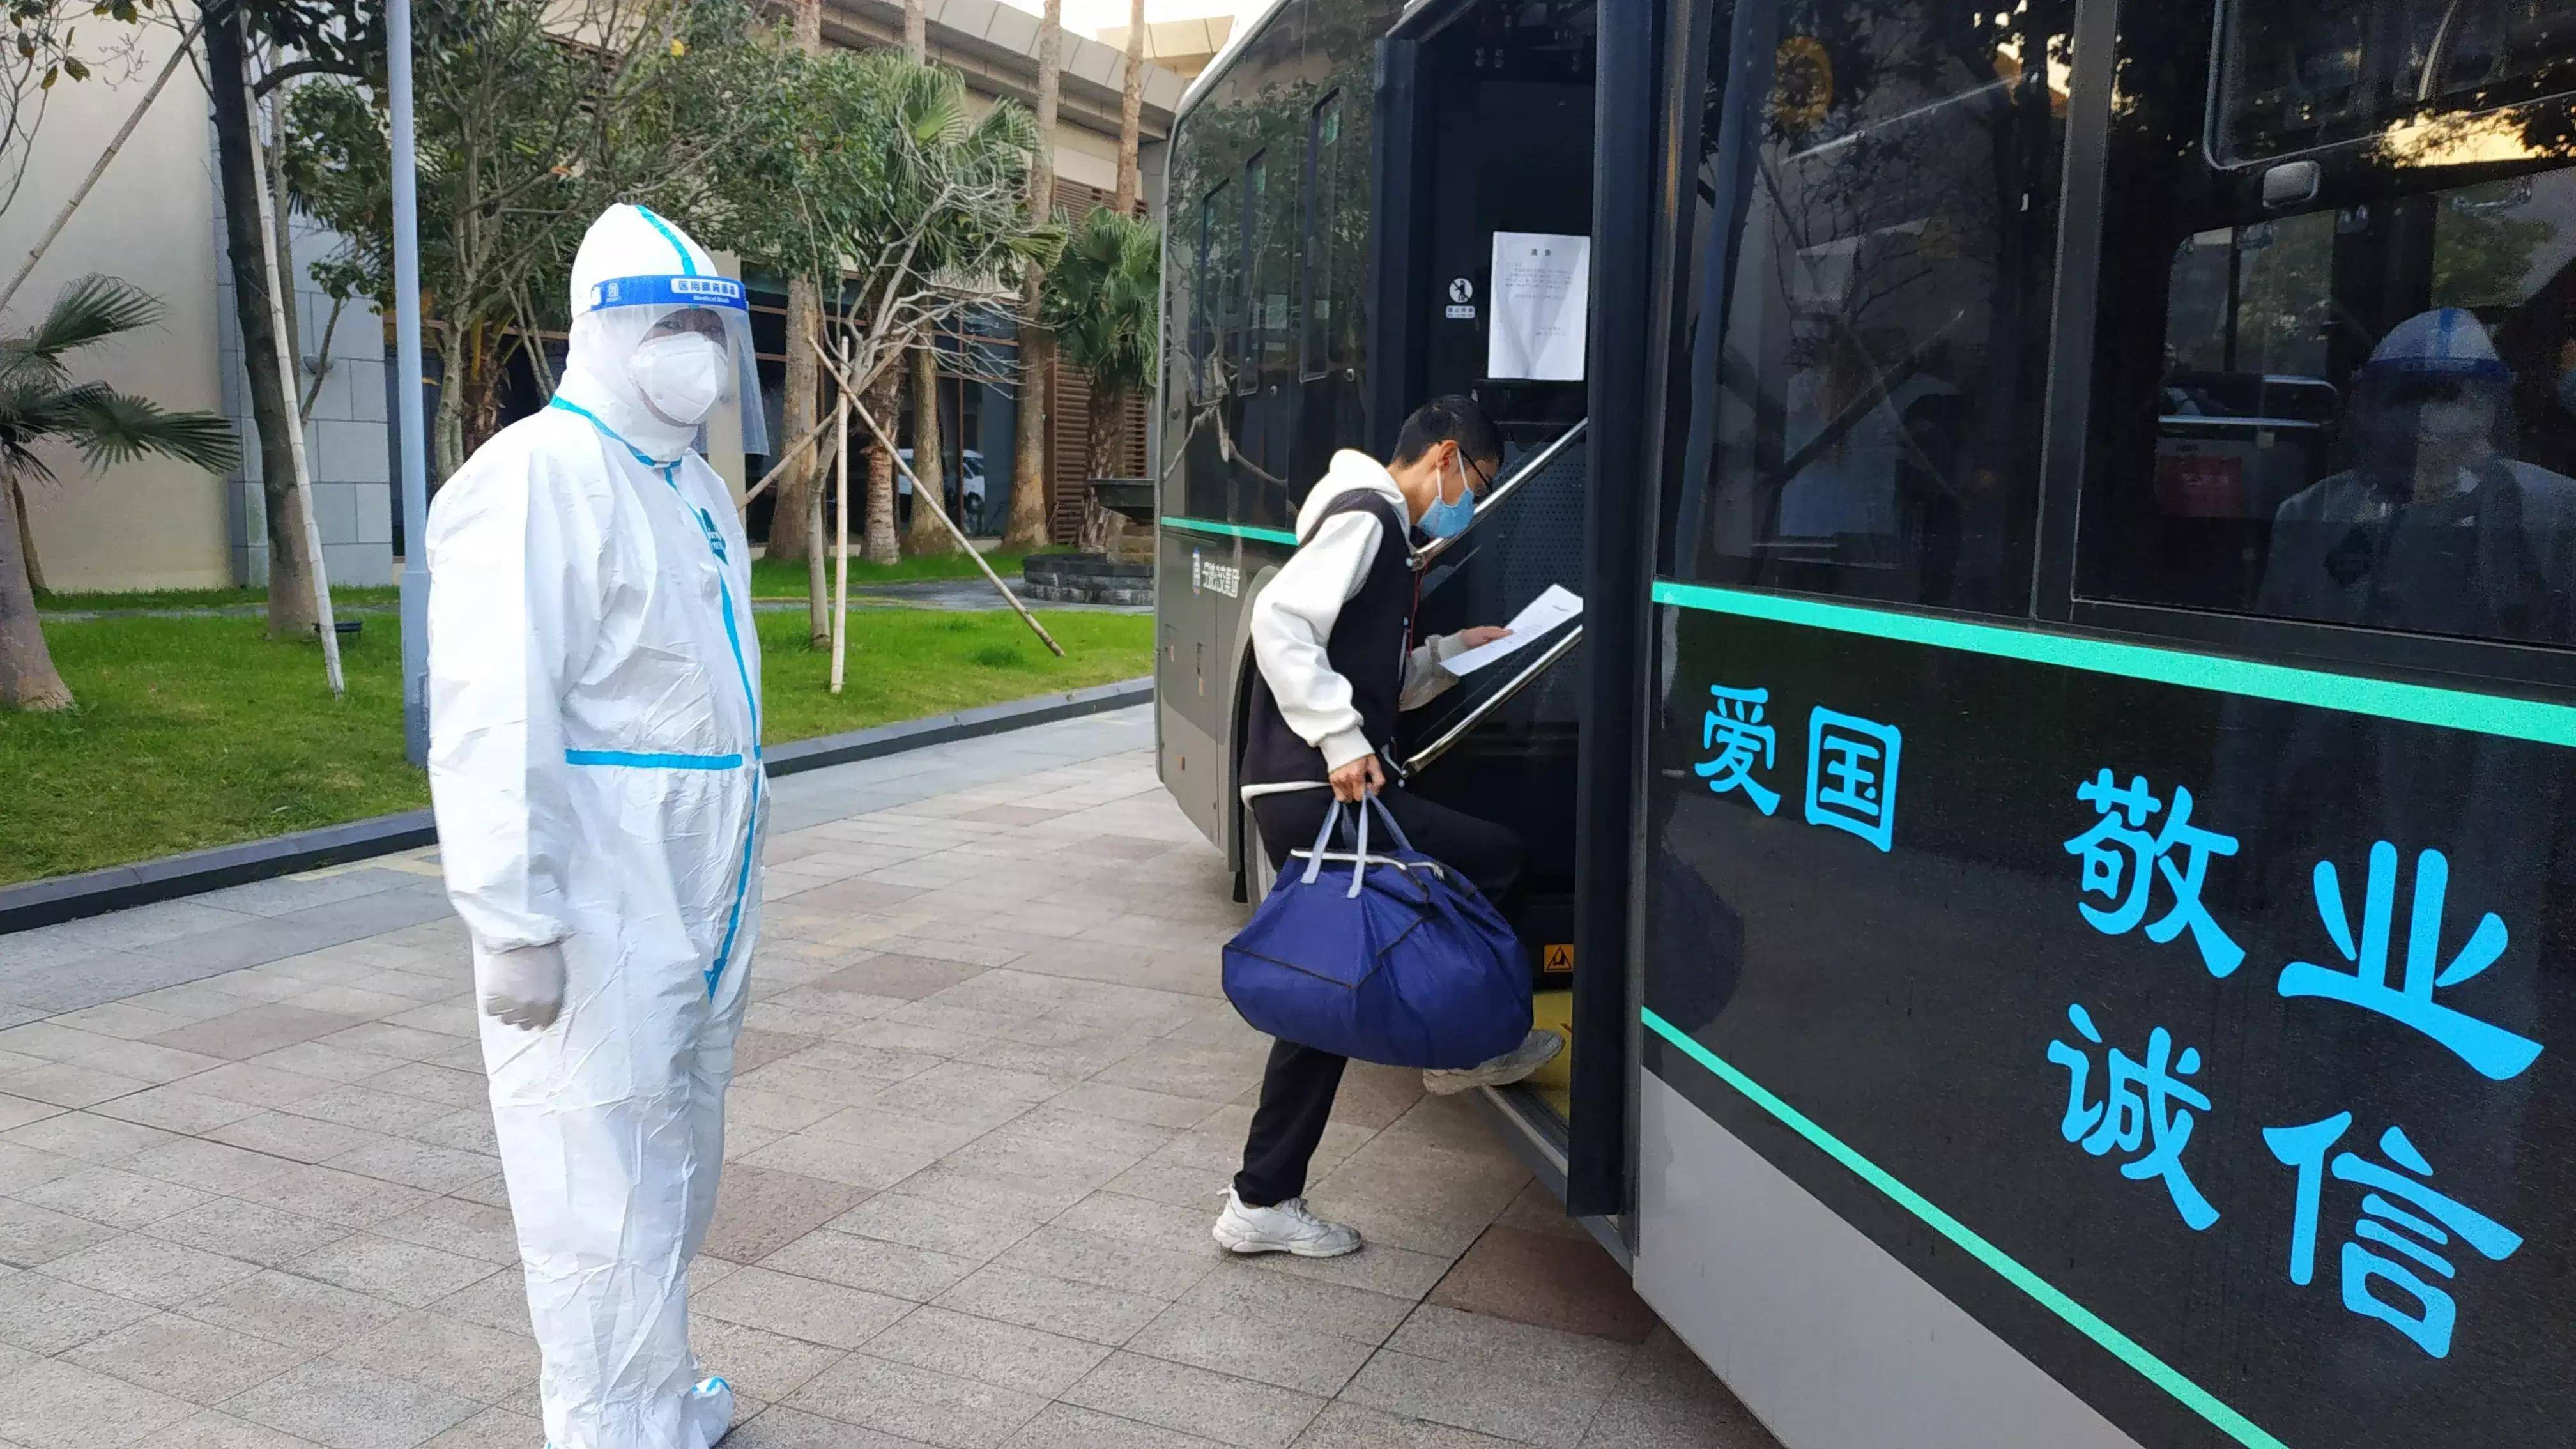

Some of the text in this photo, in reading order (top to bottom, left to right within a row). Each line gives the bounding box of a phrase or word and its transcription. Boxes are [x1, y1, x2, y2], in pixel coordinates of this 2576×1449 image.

[1695, 685, 1901, 852] 爱国
[2064, 768, 2544, 1080] 敬业
[2048, 1004, 2522, 1358] 诚信
